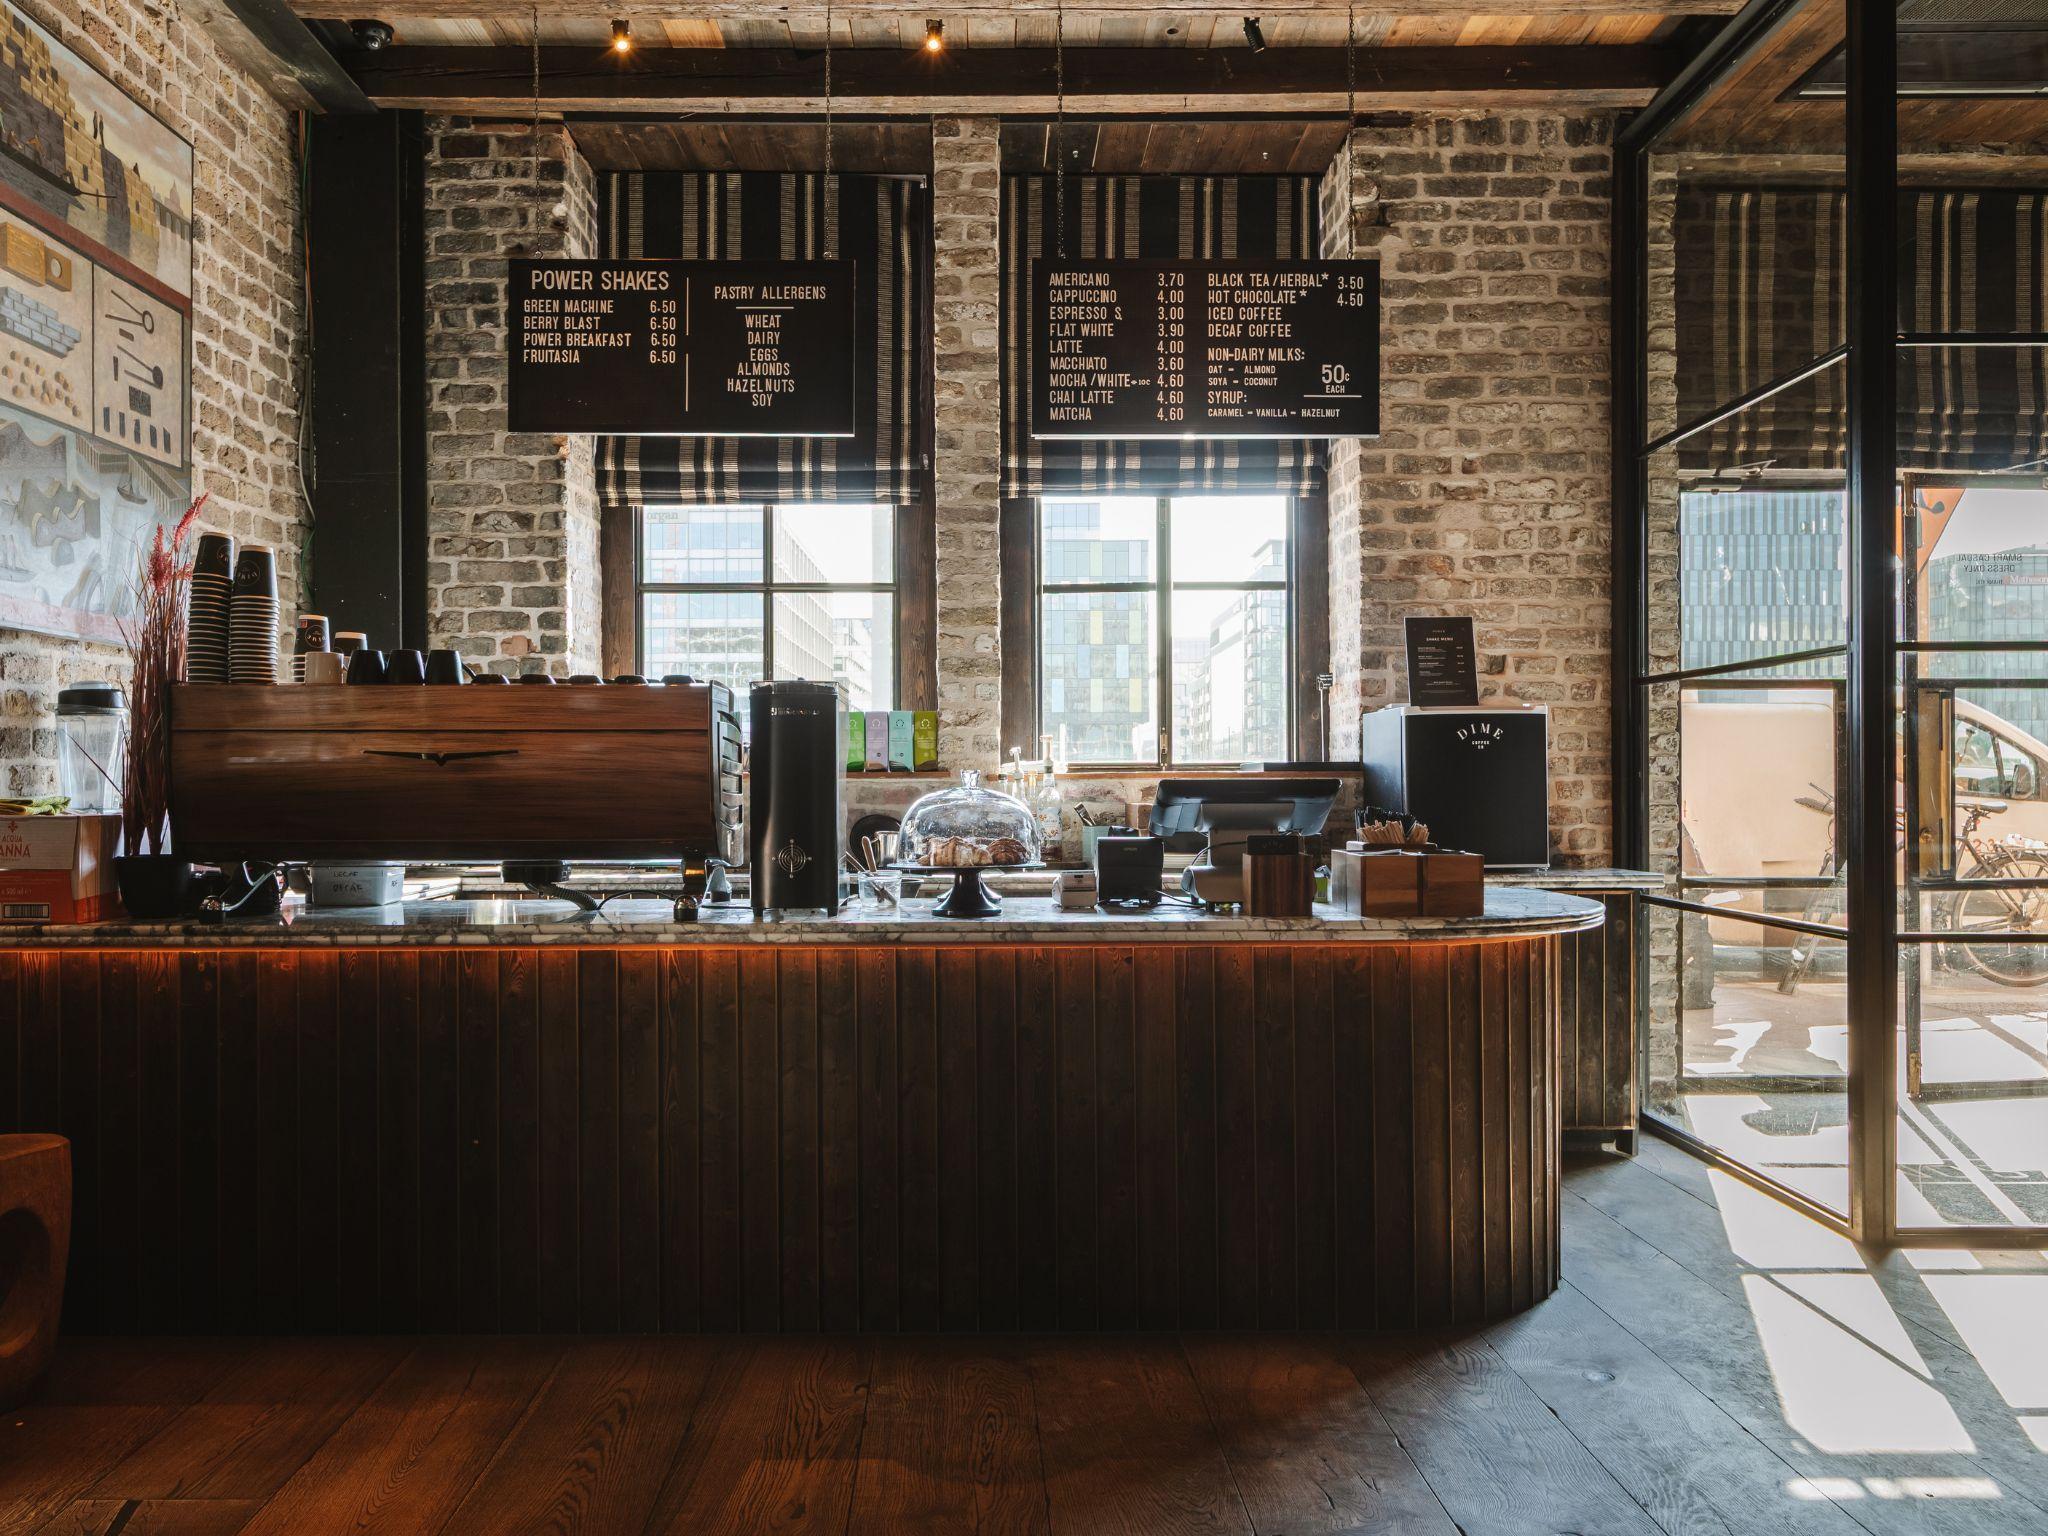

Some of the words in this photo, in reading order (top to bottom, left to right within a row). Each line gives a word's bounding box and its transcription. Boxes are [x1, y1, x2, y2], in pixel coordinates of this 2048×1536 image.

[532, 270, 592, 290] POWER
[602, 271, 669, 290] SHAKES
[1050, 273, 1109, 286] AMERICANO
[1158, 273, 1183, 287] 3.70
[1208, 273, 1243, 286] BLACK
[1250, 274, 1269, 287] TEA
[1338, 276, 1363, 289] 3.50
[715, 286, 754, 299] PASTRY
[762, 286, 825, 299] ALLERGENS
[1050, 290, 1116, 303] CAPPUCCINO
[1158, 290, 1184, 304] 4.00
[1209, 290, 1230, 303] HOT
[1337, 293, 1363, 306] 4.50
[524, 300, 559, 312] GREEN
[565, 300, 613, 313] MACHINE
[650, 300, 675, 313] 6.50
[1050, 306, 1107, 320] ESPRESSO
[1158, 307, 1184, 320] 3.00
[1208, 307, 1233, 320] ICED
[1239, 307, 1281, 320] COFFEE
[524, 316, 558, 329] BERRY
[565, 316, 600, 329] BLAST
[650, 317, 676, 330] 6.50
[745, 315, 781, 328] WHEAT
[1050, 323, 1076, 336] FLAT
[1081, 323, 1114, 336] WHITE
[1158, 324, 1184, 337] 3.90
[1208, 324, 1243, 337] DECAF
[1249, 324, 1291, 337] COFFEE
[524, 333, 561, 346] POWER
[567, 333, 631, 346] BREAKFAST
[651, 333, 675, 346] 6.50
[748, 331, 780, 344] DAIRY
[1050, 340, 1082, 353] LATTE
[1157, 340, 1183, 354] 4.00
[524, 349, 579, 363] FRUITASIA
[650, 350, 675, 363] 6.50
[751, 348, 778, 361] EGGS
[1208, 348, 1264, 361] NON-DAIRY
[1269, 348, 1305, 361] MILKS:
[738, 362, 789, 376] ALMONDS
[1051, 357, 1106, 370] MACCHIATO
[1158, 357, 1183, 371] 3.60
[1208, 365, 1222, 374] OAT
[1244, 365, 1275, 374] ALMOND
[728, 378, 794, 392] HAZELNUTS
[1050, 374, 1087, 387] MOCHA
[1157, 374, 1183, 388] 4.60
[1208, 377, 1227, 386] SOYA
[1244, 377, 1278, 386] COCONUT
[1326, 385, 1345, 393] EACH
[752, 394, 772, 406] SOY
[1050, 391, 1074, 403] CHAI
[1081, 390, 1114, 404] LATTE
[1157, 391, 1183, 405] 4.60
[1208, 391, 1247, 404] SYRUP:
[1050, 407, 1091, 420] MATCHA
[1157, 408, 1184, 422] 4.60
[1208, 408, 1244, 417] CARAMEL
[1256, 409, 1287, 417] VANILLA
[1302, 409, 1340, 417] HAZELNUT
[1457, 723, 1503, 740] DIME
